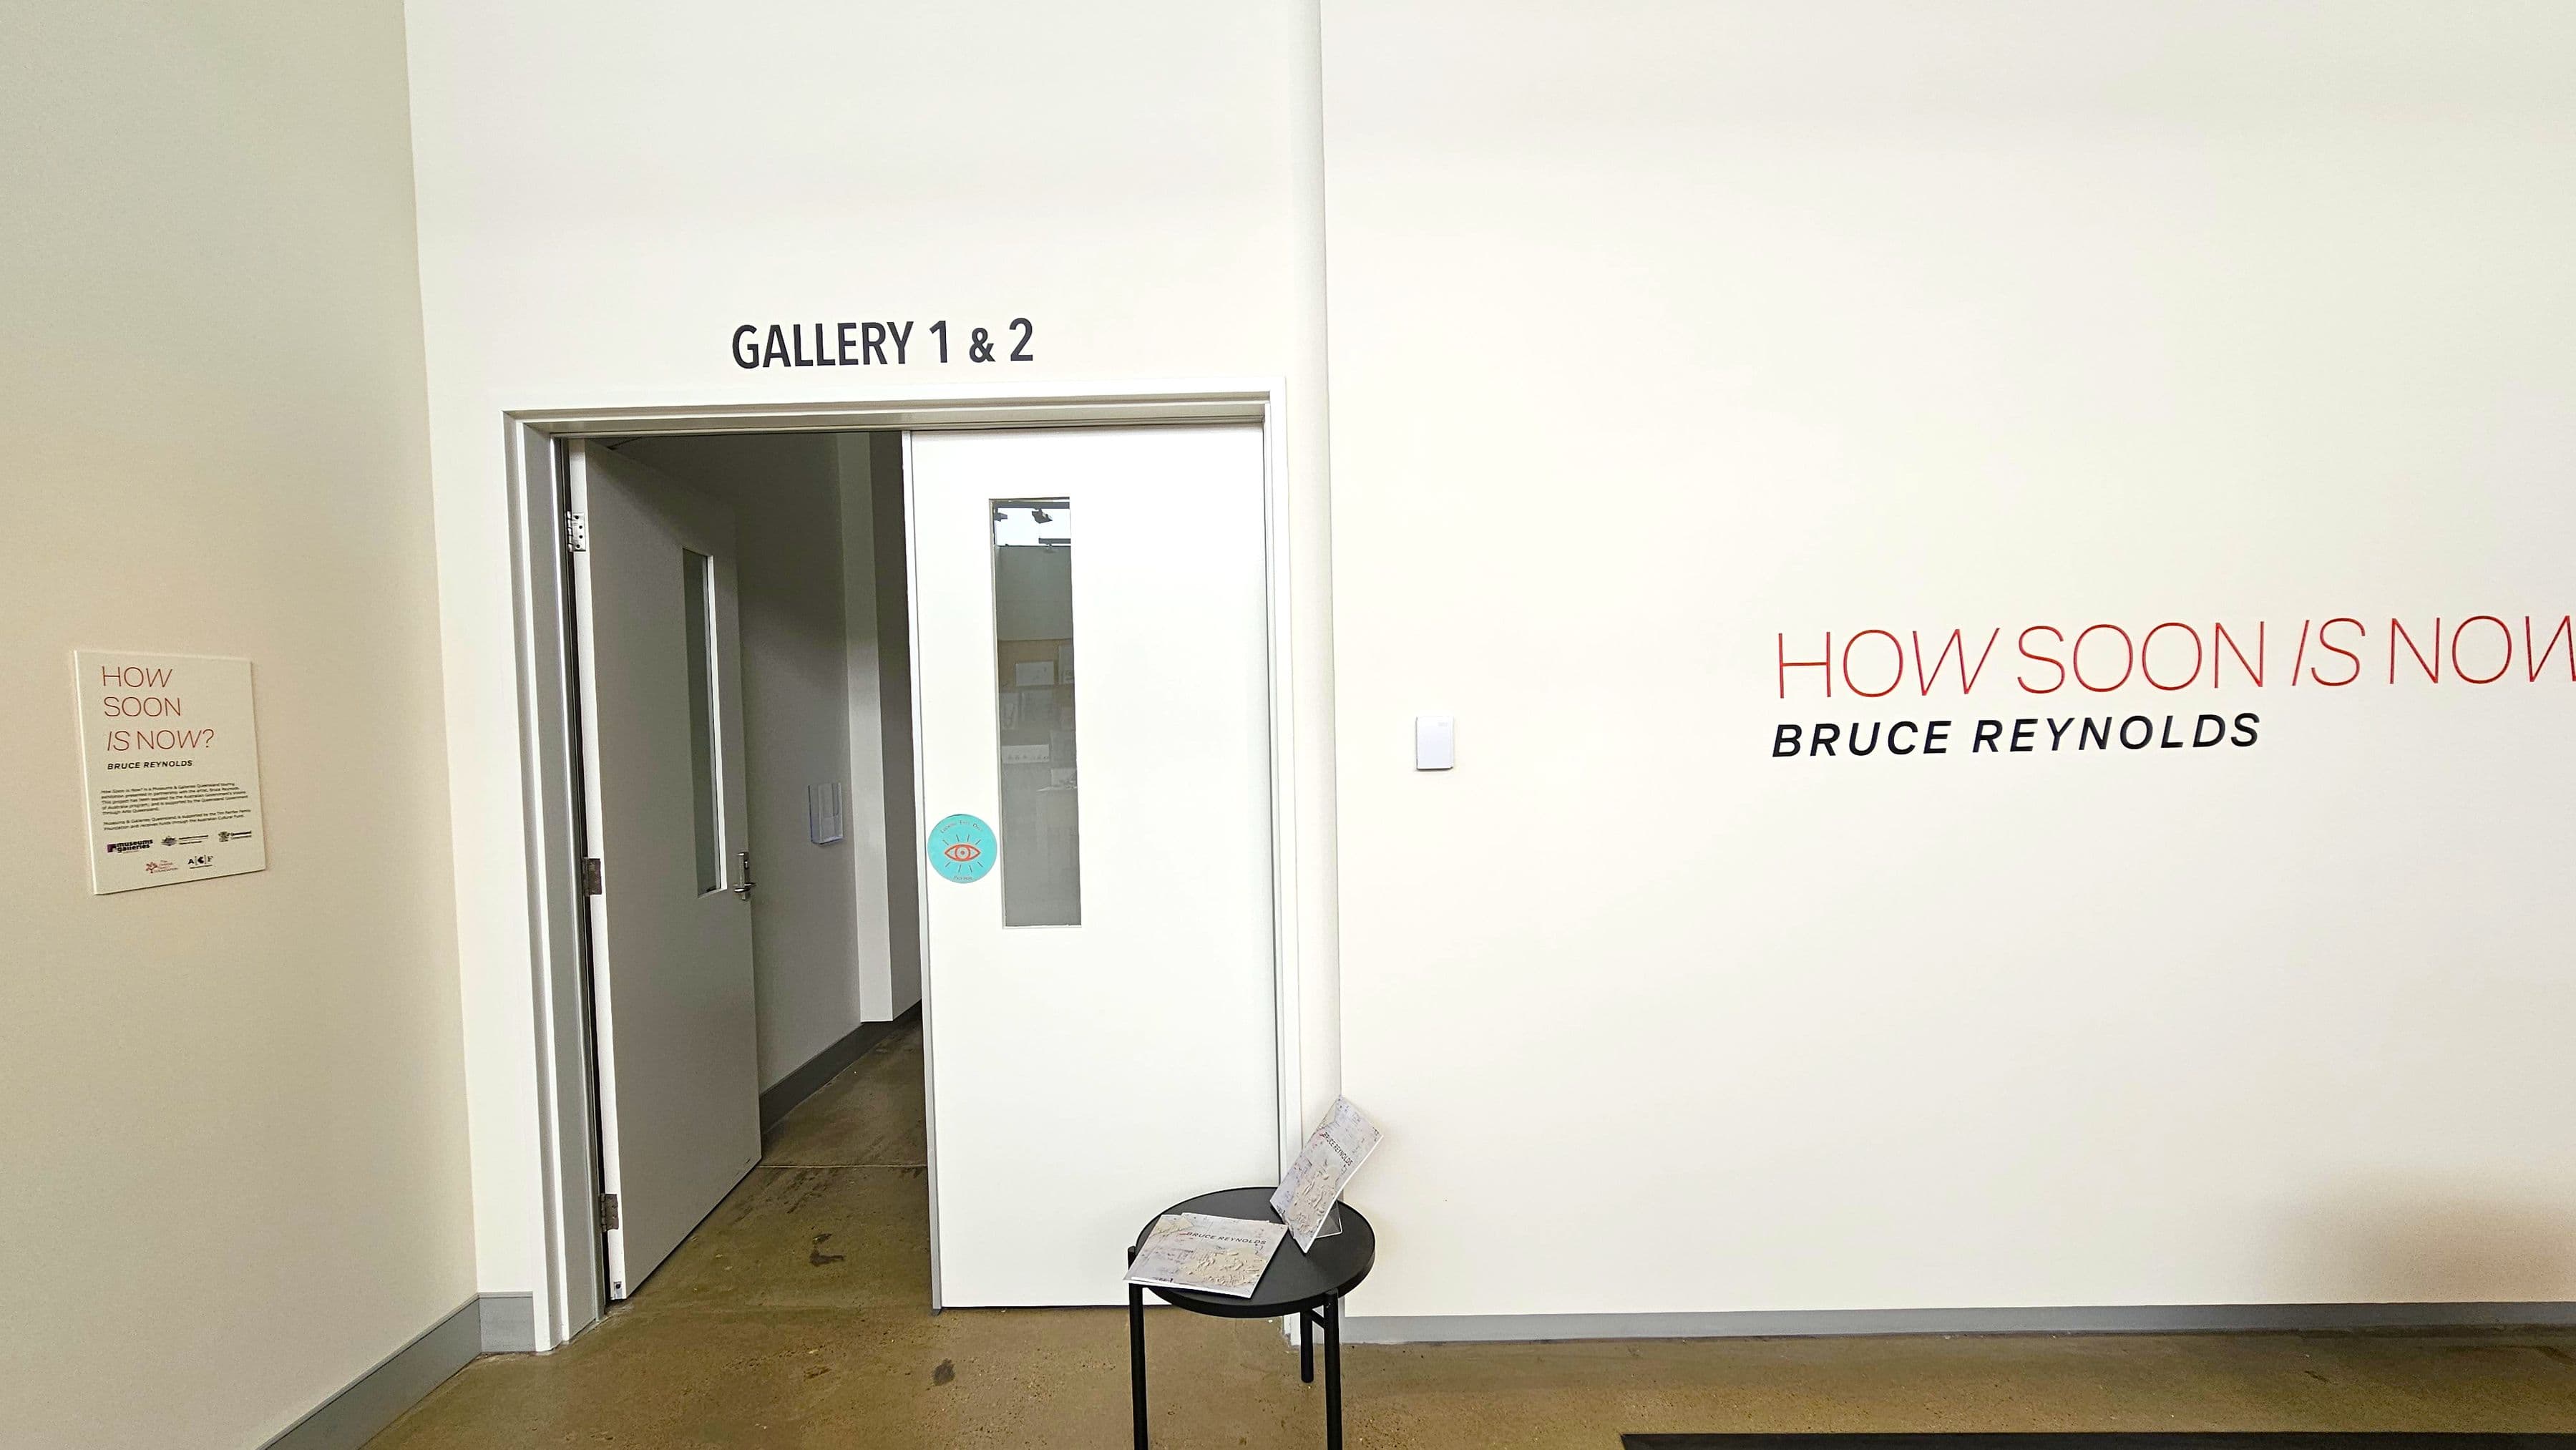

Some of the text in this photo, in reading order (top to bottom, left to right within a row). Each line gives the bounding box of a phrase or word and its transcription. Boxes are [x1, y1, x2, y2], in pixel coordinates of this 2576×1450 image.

[733, 318, 1033, 369] GALLERY 1 & 2
[1779, 628, 2000, 699] HOW
[2018, 621, 2264, 694] SOON
[2293, 618, 2365, 686] IS
[102, 666, 172, 687] HOW
[104, 697, 180, 716] SOON
[107, 729, 214, 751] IS NOW?
[1772, 713, 2259, 757] BRUCE REYNOLDS
